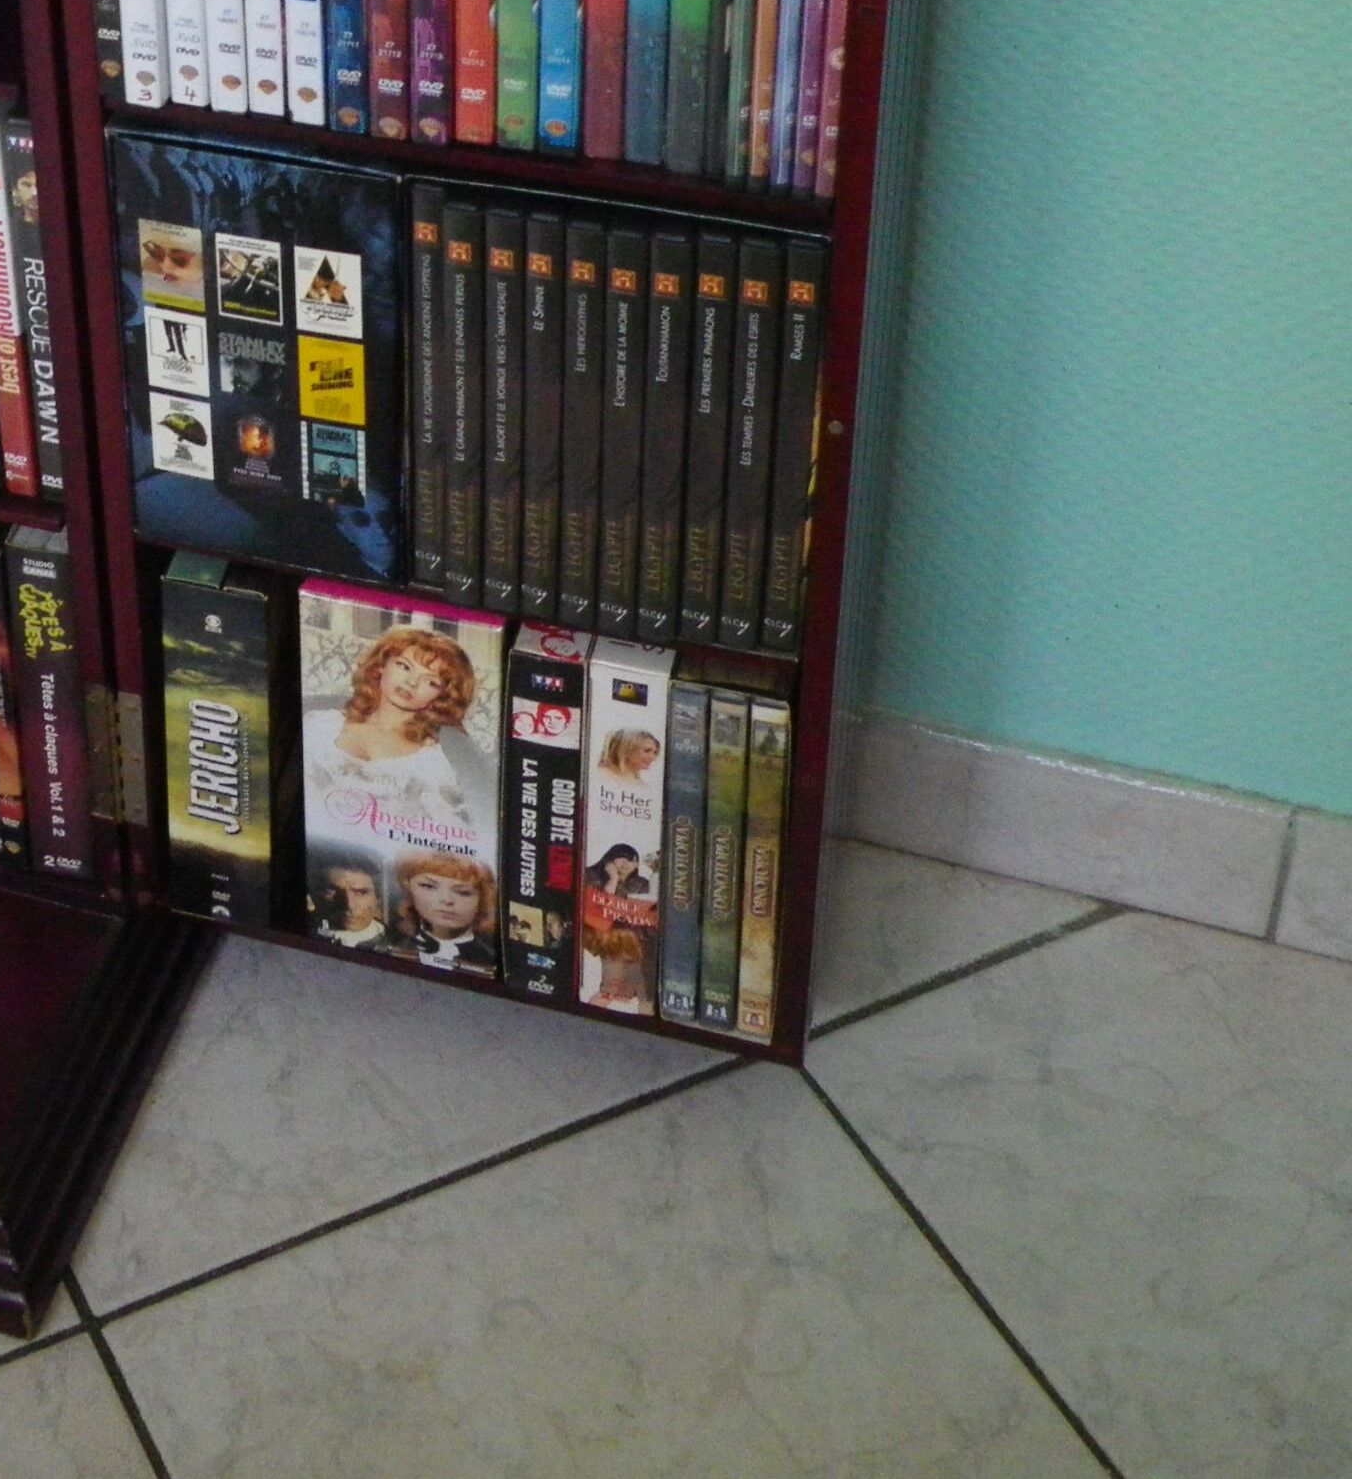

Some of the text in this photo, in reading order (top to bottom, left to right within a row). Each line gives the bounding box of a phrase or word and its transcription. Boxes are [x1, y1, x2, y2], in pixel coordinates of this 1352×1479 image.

[138, 89, 152, 101] 3
[184, 85, 196, 101] 4
[23, 256, 60, 445] RESCUE DAWN
[40, 673, 55, 714] Têtes
[44, 725, 59, 775] claques
[187, 699, 241, 835] JERICHO
[551, 778, 576, 814] GOOD
[600, 785, 653, 807] In Her
[600, 802, 652, 819] SHOES
[325, 785, 478, 842] Angélique
[519, 757, 538, 898] LA VIE DES AUTRES
[53, 826, 65, 837] 2
[387, 829, 478, 857] L'Intégrale
[549, 817, 575, 845] BYE
